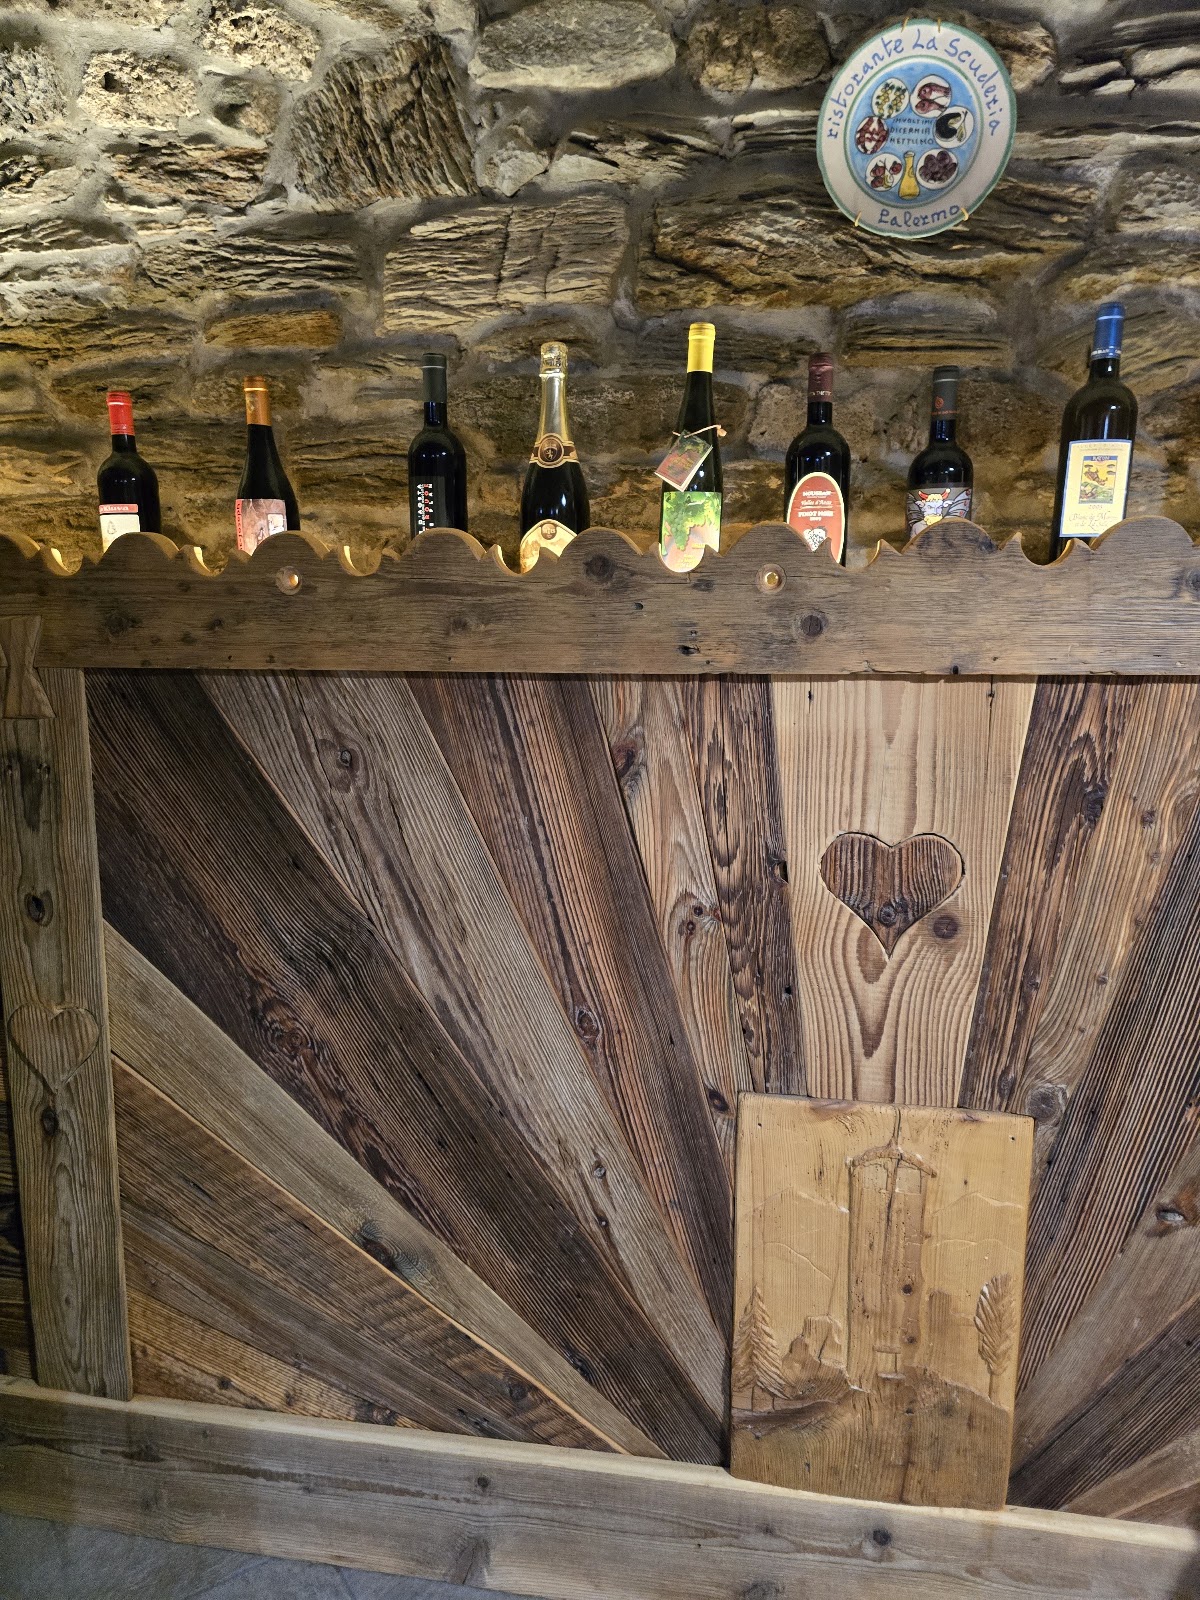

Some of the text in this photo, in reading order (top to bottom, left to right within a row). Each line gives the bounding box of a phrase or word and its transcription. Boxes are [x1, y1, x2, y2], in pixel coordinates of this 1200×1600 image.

[912, 28, 939, 51] La
[944, 37, 1001, 136] Scuderia
[877, 204, 960, 227] Palermo
